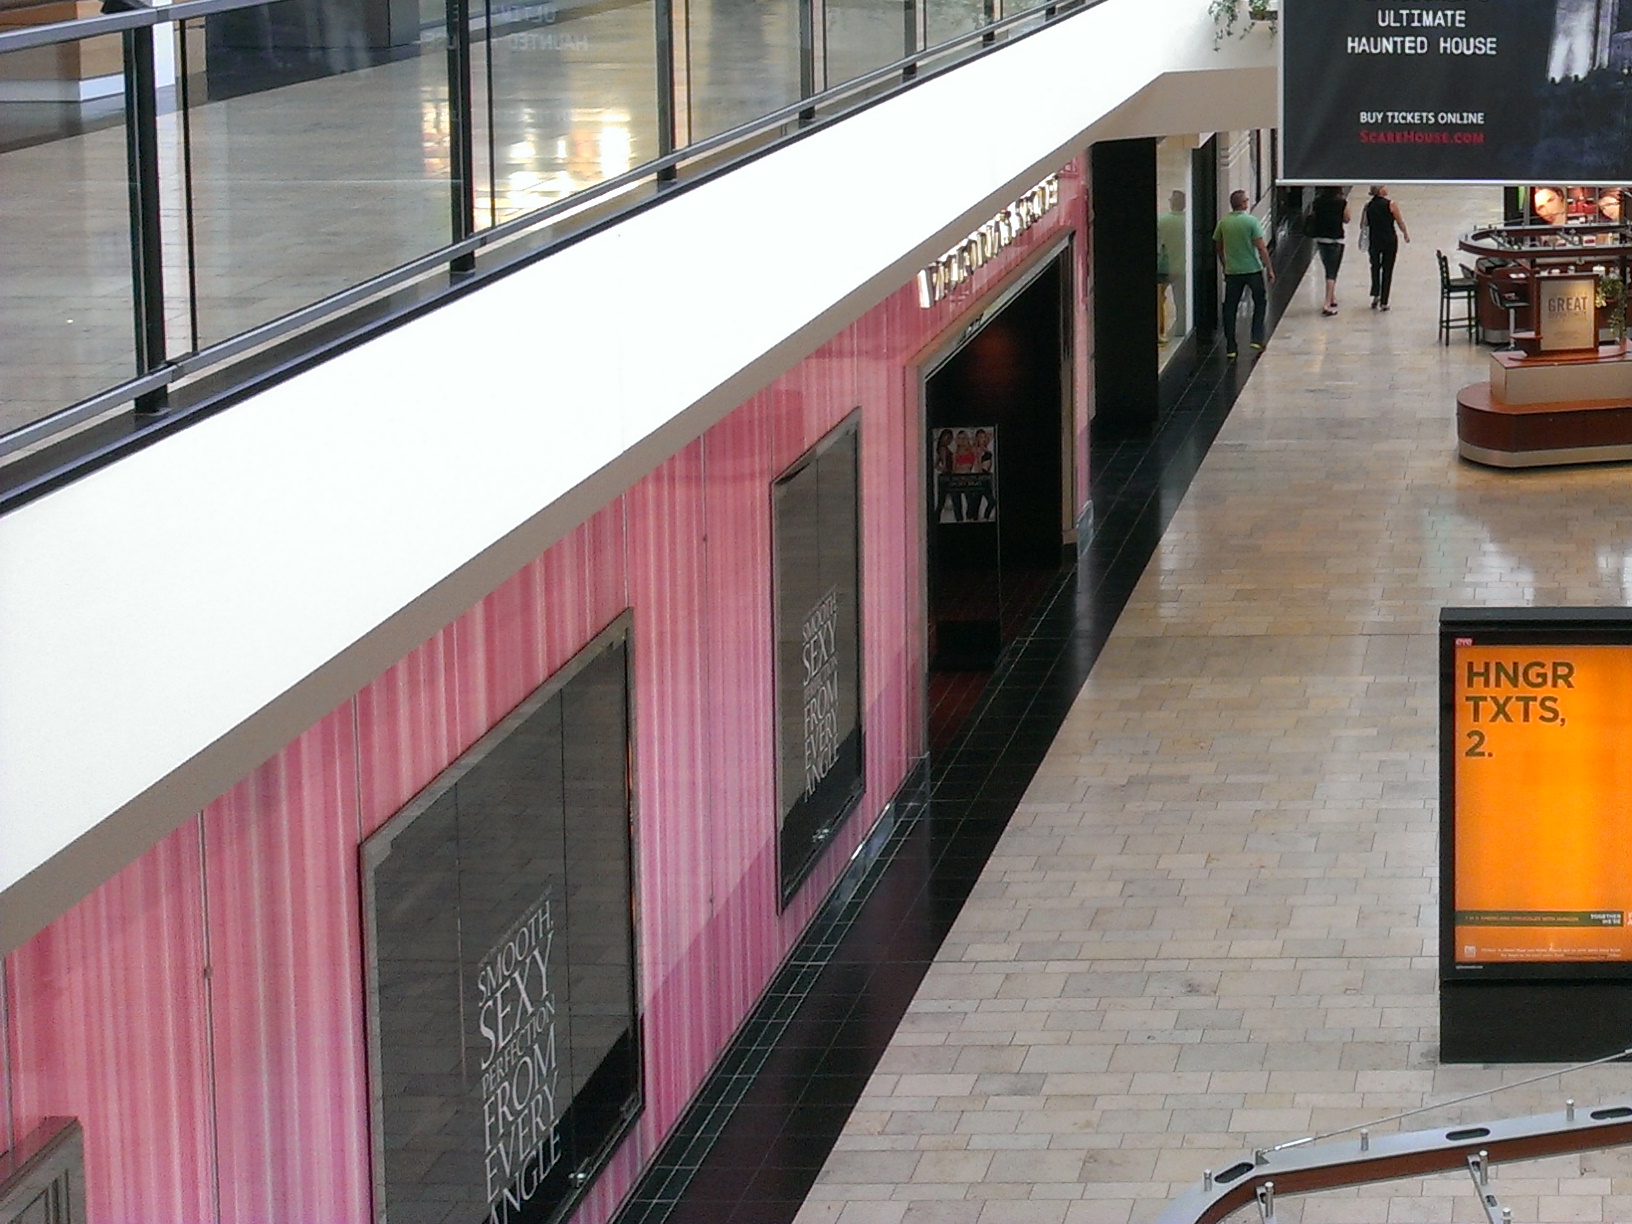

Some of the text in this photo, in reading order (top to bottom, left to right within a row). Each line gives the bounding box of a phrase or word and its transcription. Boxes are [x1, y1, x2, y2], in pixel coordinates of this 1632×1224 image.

[1347, 36, 1497, 55] HAUNTED HOUSE
[1377, 10, 1466, 27] ULTIMATE
[1360, 112, 1485, 124] BUY TICKETS ONLINE
[1548, 296, 1587, 312] GREAT
[803, 613, 838, 687] SEXY
[1466, 661, 1575, 689] HNGR
[804, 670, 839, 739] FROM
[804, 702, 839, 771] EVERY
[1465, 695, 1566, 727] TXTS,
[804, 732, 840, 804] ANGLE
[1465, 729, 1494, 757] 2.
[480, 929, 554, 1071] SEXY
[482, 993, 555, 1099] PERFECTION
[483, 1022, 556, 1154] FROM
[485, 1069, 558, 1204] EVERY
